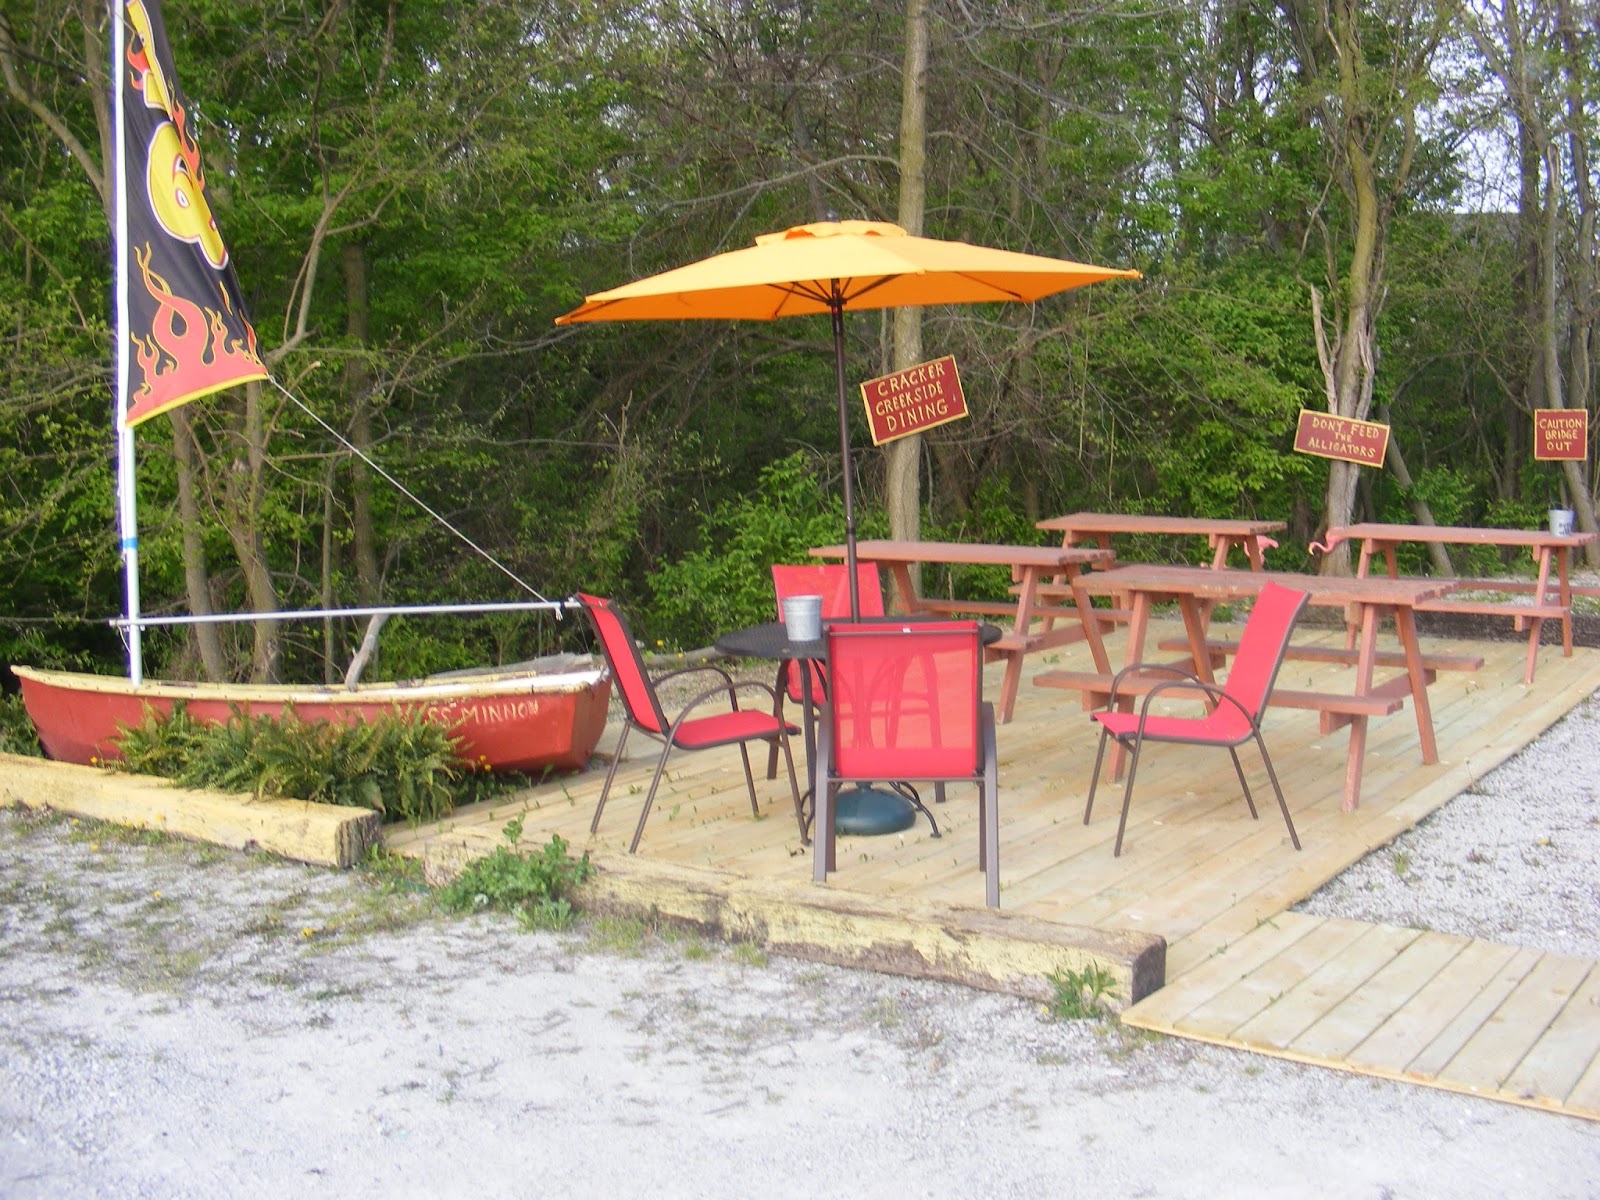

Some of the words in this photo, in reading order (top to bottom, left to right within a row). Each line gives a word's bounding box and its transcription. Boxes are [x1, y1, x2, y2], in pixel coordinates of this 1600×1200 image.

[877, 362, 946, 397] CRACKER
[875, 380, 944, 417] CREEKSIDE
[886, 398, 948, 433] DINING
[1539, 418, 1582, 430] CAUTION
[1334, 431, 1352, 443] THE
[1350, 423, 1380, 440] FEED
[1545, 429, 1578, 441] BRIDGE
[1308, 436, 1376, 459] ALLIGATORS
[1546, 441, 1572, 452] OUT
